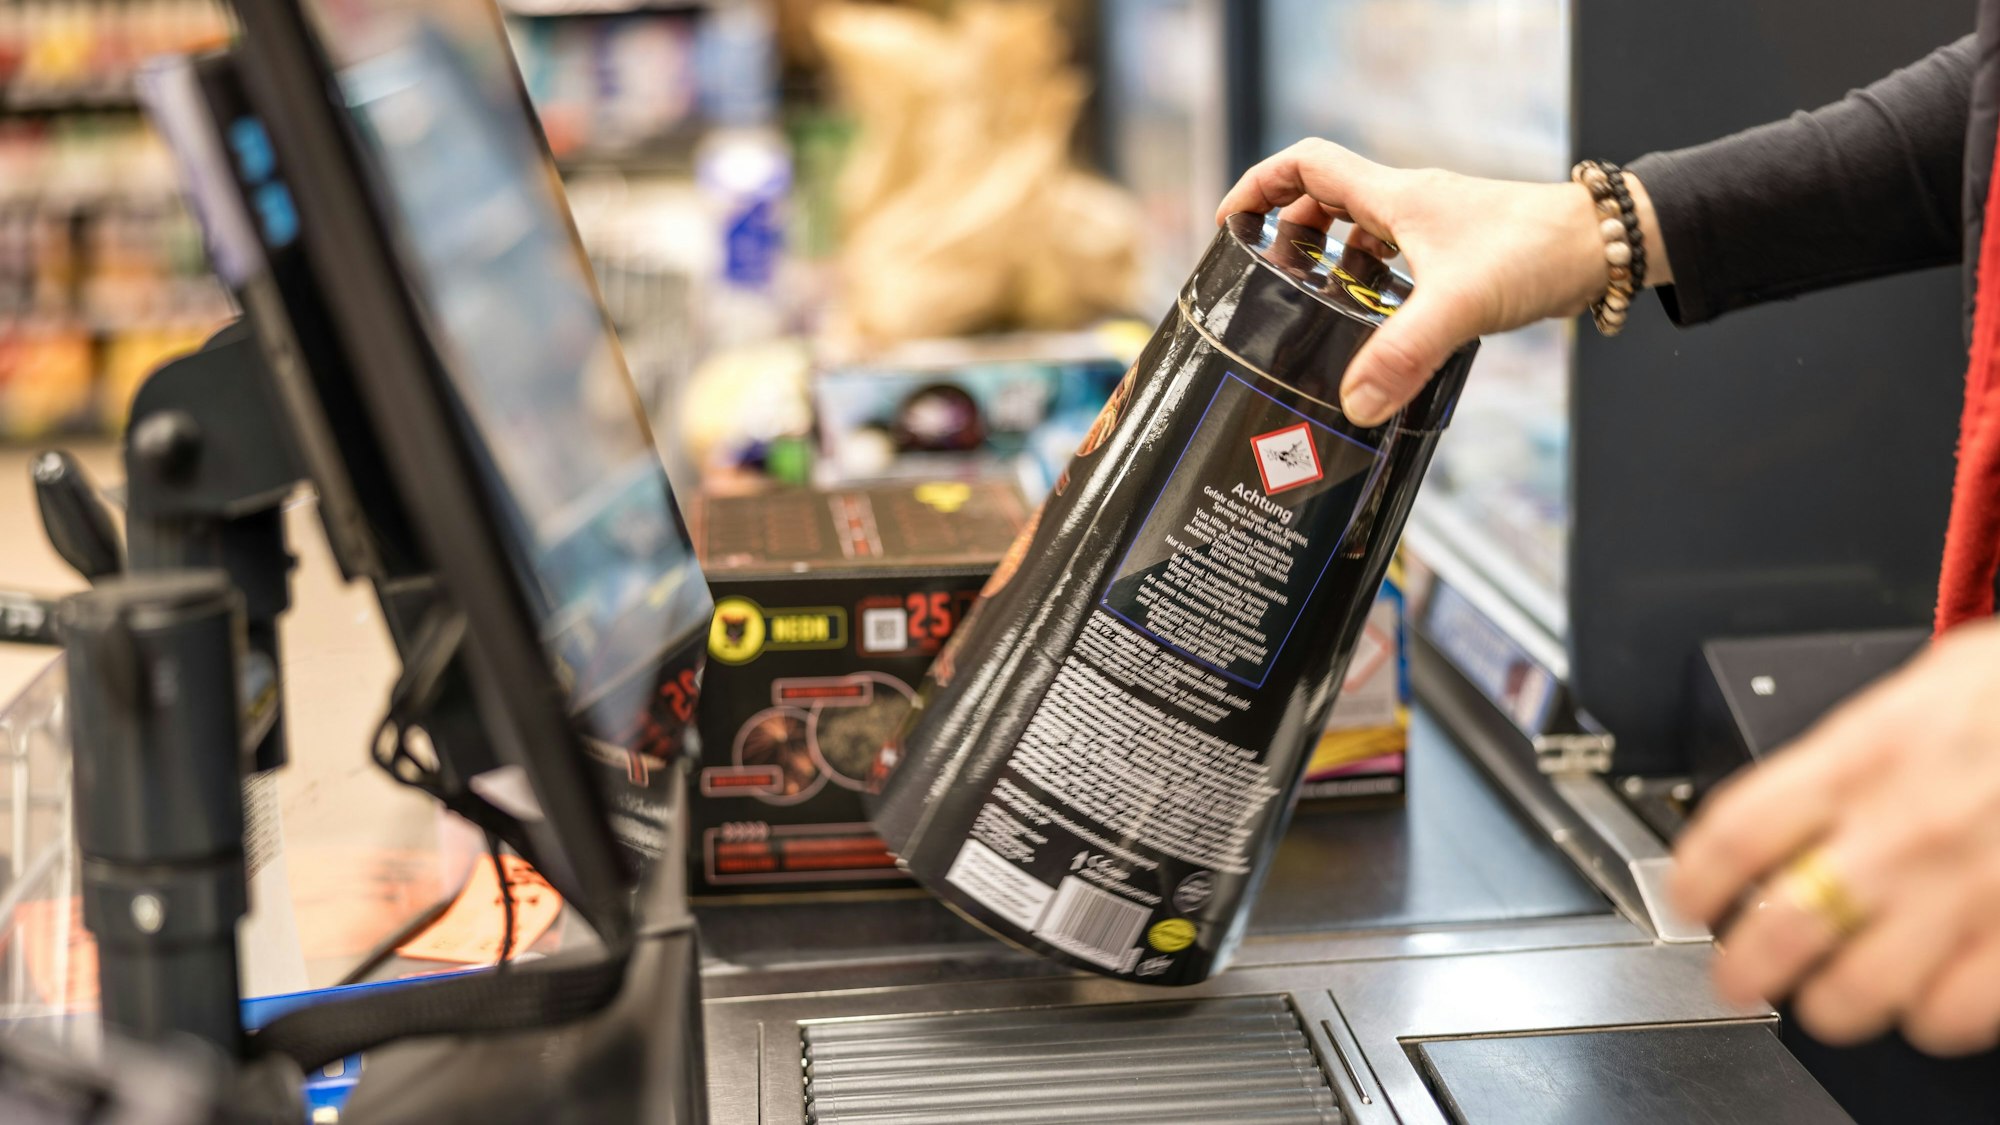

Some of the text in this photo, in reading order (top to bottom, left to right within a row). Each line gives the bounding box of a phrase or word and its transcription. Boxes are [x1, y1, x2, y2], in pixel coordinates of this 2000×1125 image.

[1204, 486, 1226, 504] Gefahr
[1227, 500, 1247, 515] durch
[1247, 510, 1266, 525] Feuer
[1267, 521, 1284, 534] oder
[1213, 502, 1239, 522] Spreng-
[1240, 518, 1255, 529] und
[1232, 482, 1292, 524] Achtung
[1184, 524, 1212, 544] anderen
[1192, 516, 1216, 538] Funken,
[1218, 533, 1245, 552] offenen
[1244, 546, 1276, 567] Flammen
[1196, 508, 1209, 521] Von
[1207, 516, 1228, 533] Hitze,
[1229, 526, 1253, 545] heißen
[1165, 534, 1179, 547] Nur
[1177, 542, 1185, 552] in
[1208, 547, 1228, 563] Nicht
[1144, 574, 1156, 584] An
[907, 593, 951, 639] 25
